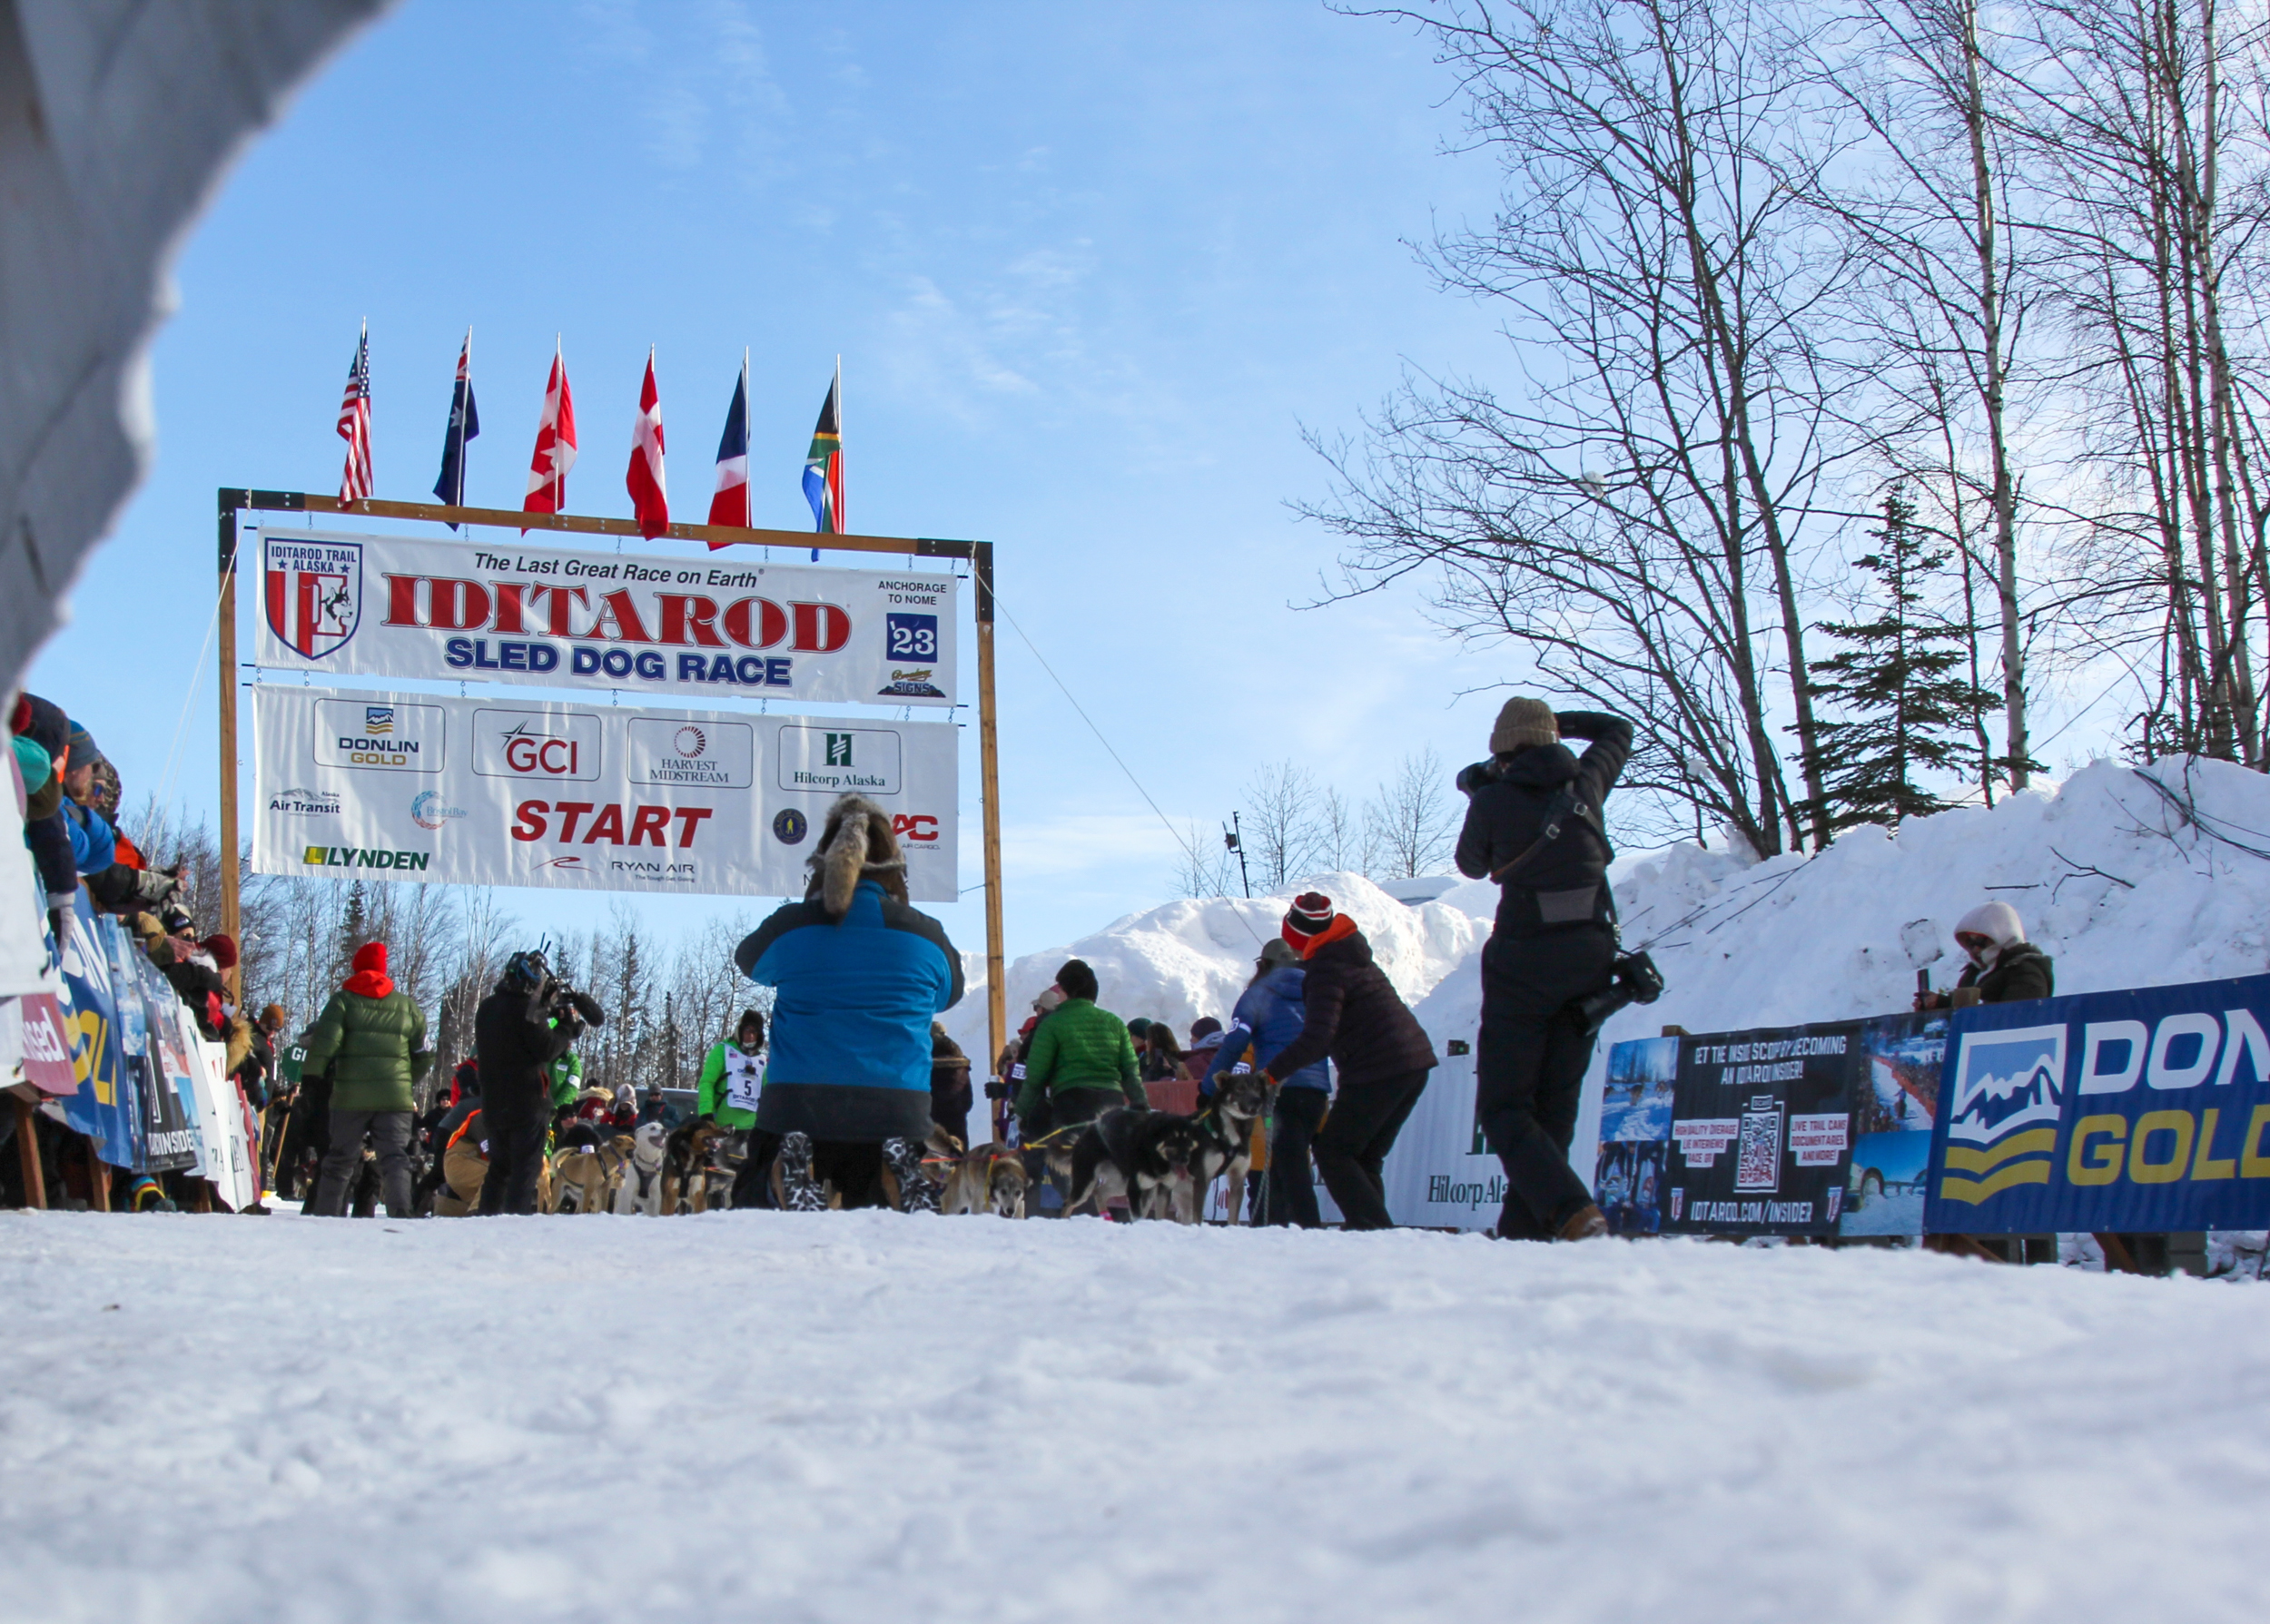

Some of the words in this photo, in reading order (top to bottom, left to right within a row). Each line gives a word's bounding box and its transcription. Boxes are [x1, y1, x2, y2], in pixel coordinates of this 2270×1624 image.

[271, 546, 322, 560] IDITAROD
[325, 549, 357, 563] TRAIL
[292, 559, 335, 574] ALASKA
[474, 552, 511, 572] The
[516, 555, 560, 575] Last
[564, 559, 619, 579] Great
[622, 564, 671, 584] Race
[676, 571, 701, 586] on
[877, 580, 947, 594] ANCHORAGE
[888, 593, 902, 605] TO
[904, 594, 937, 605] NOME
[380, 572, 852, 655] IDITAROD
[444, 636, 561, 674] SLED
[570, 645, 666, 681] DOG
[676, 652, 793, 688] RACE
[893, 681, 931, 694] SIGNS
[339, 737, 419, 753] DONLIN
[350, 752, 406, 765] GOLD
[506, 737, 577, 774] GCI
[661, 758, 717, 771] HARVEST
[649, 769, 729, 783] MIDSTREAM
[794, 771, 840, 788] Hilcorp
[843, 773, 885, 787] Alaska
[269, 800, 291, 811] Air
[292, 801, 340, 813] Transit
[427, 806, 452, 815] Bristol
[453, 808, 468, 817] Bay
[510, 800, 713, 848] START
[891, 813, 939, 841] AC
[327, 848, 430, 871] LYNDEN
[611, 861, 660, 872] RYAN
[666, 863, 695, 874] AIR
[744, 1080, 752, 1096] 5
[1791, 1135, 1844, 1147] DOCUMENTARES
[1427, 1175, 1482, 1211] Hilcorp
[1486, 1175, 1509, 1204] Ala
[1690, 1199, 1813, 1224] IDTAROD.COM/INSIDER
